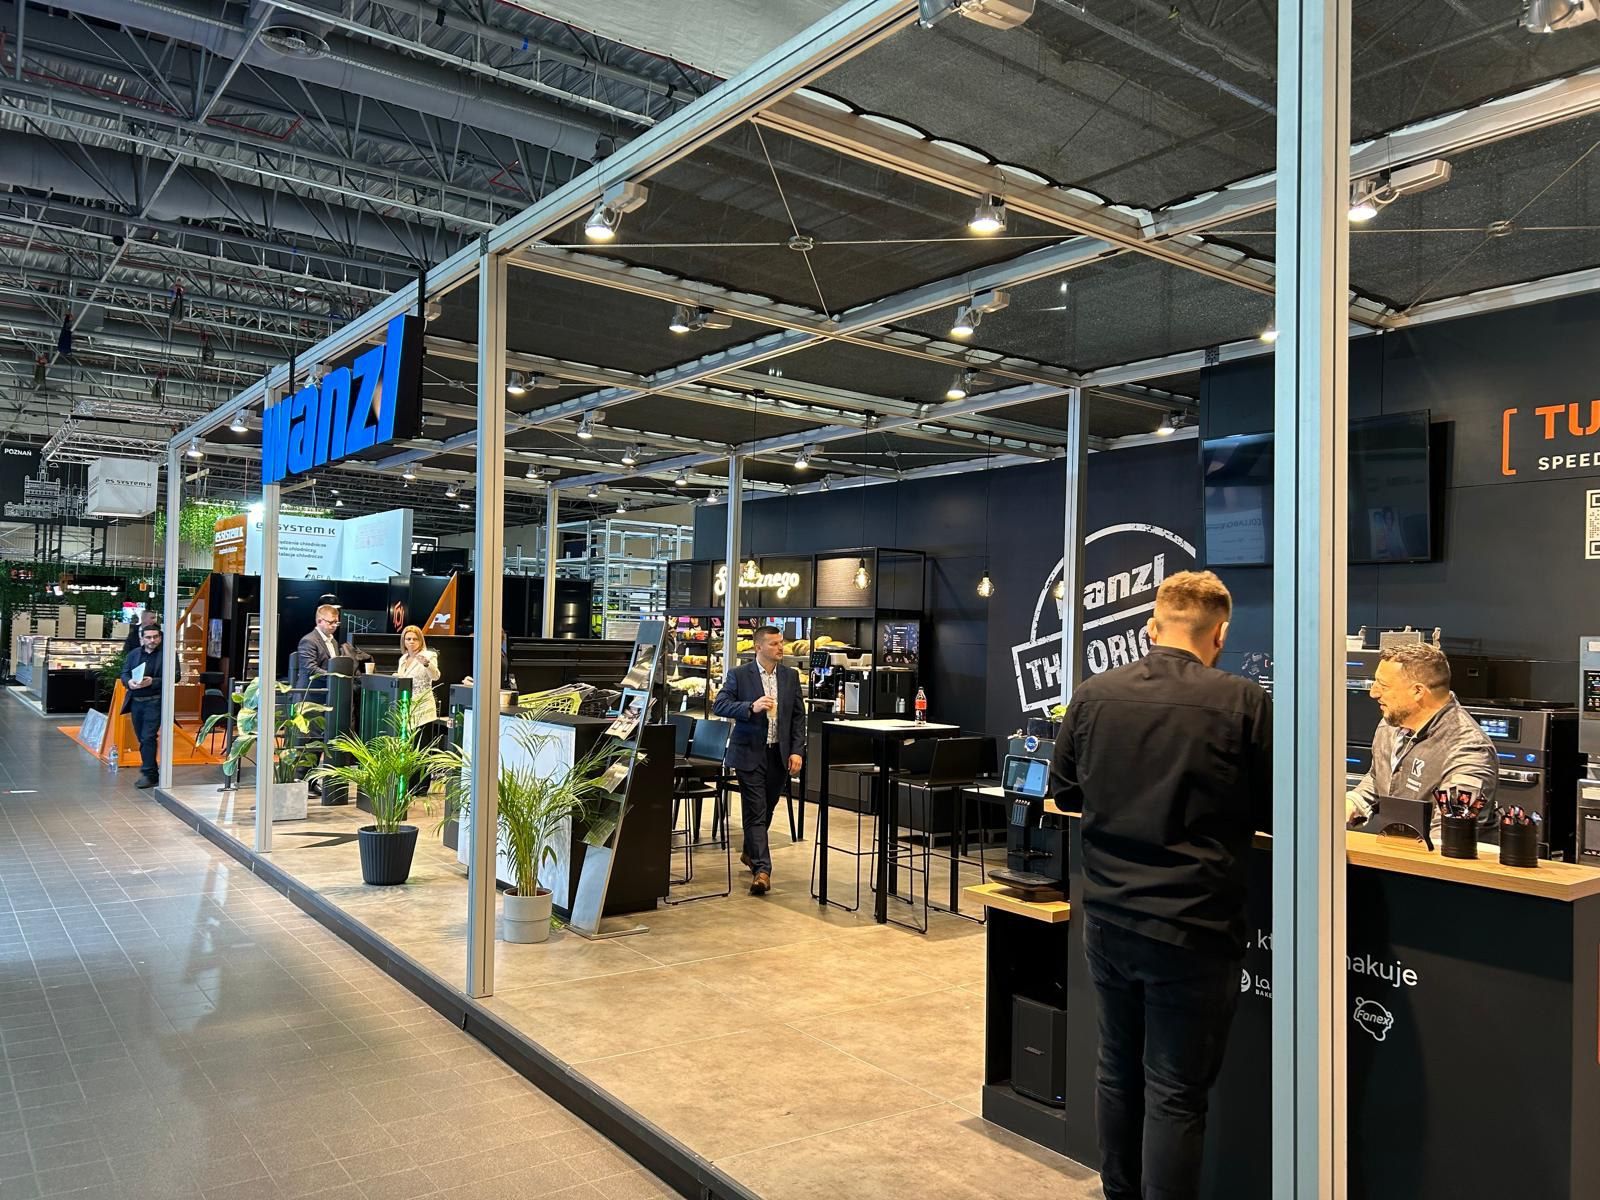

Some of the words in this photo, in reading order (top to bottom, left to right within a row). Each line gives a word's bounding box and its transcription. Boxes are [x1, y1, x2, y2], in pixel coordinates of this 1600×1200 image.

[261, 314, 405, 485] wanzl
[4, 447, 32, 457] POZNAŃ
[1026, 652, 1062, 691] TH
[1255, 989, 1273, 999] BAKE
[1356, 1009, 1391, 1026] Fanex
